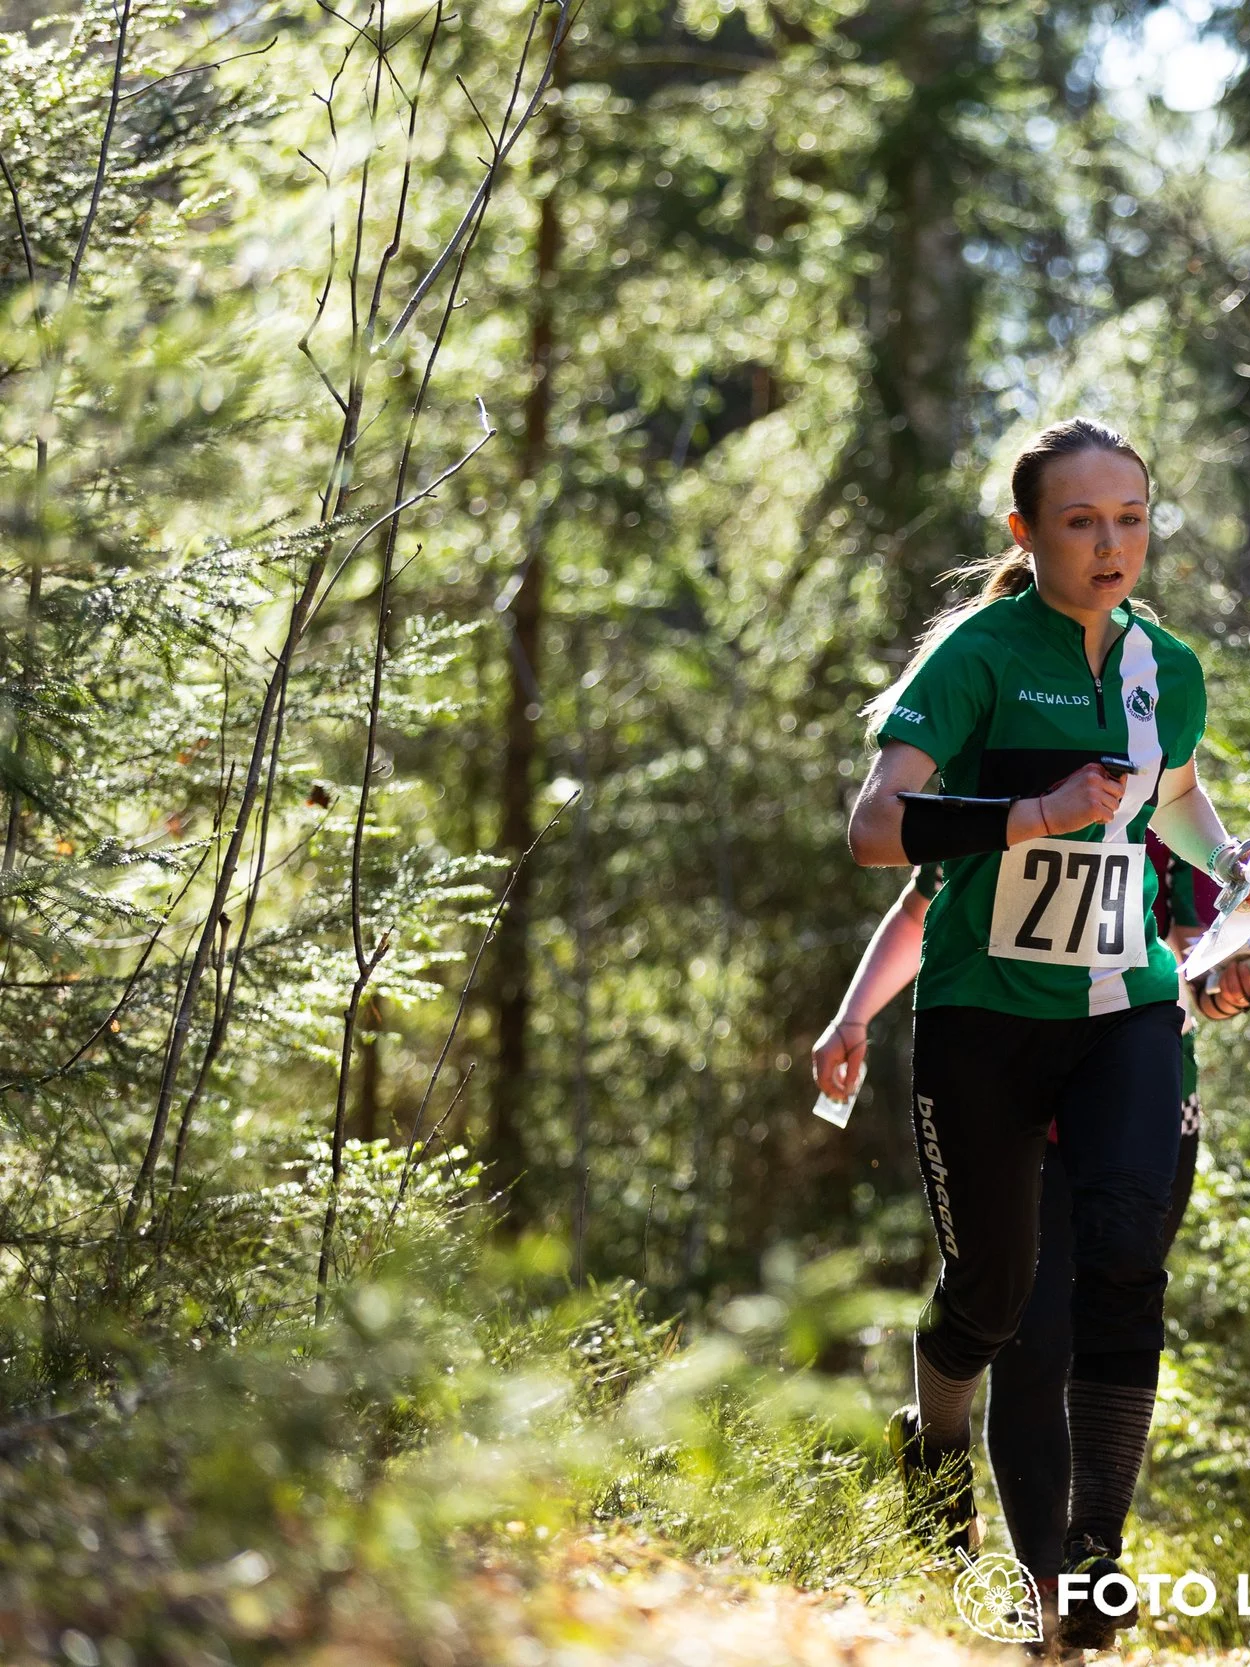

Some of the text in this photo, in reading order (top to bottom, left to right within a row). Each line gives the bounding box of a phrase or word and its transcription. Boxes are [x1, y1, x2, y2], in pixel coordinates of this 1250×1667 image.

[1018, 689, 1090, 706] ALEWALDS
[1014, 848, 1130, 955] 279
[916, 1093, 960, 1259] bagheera
